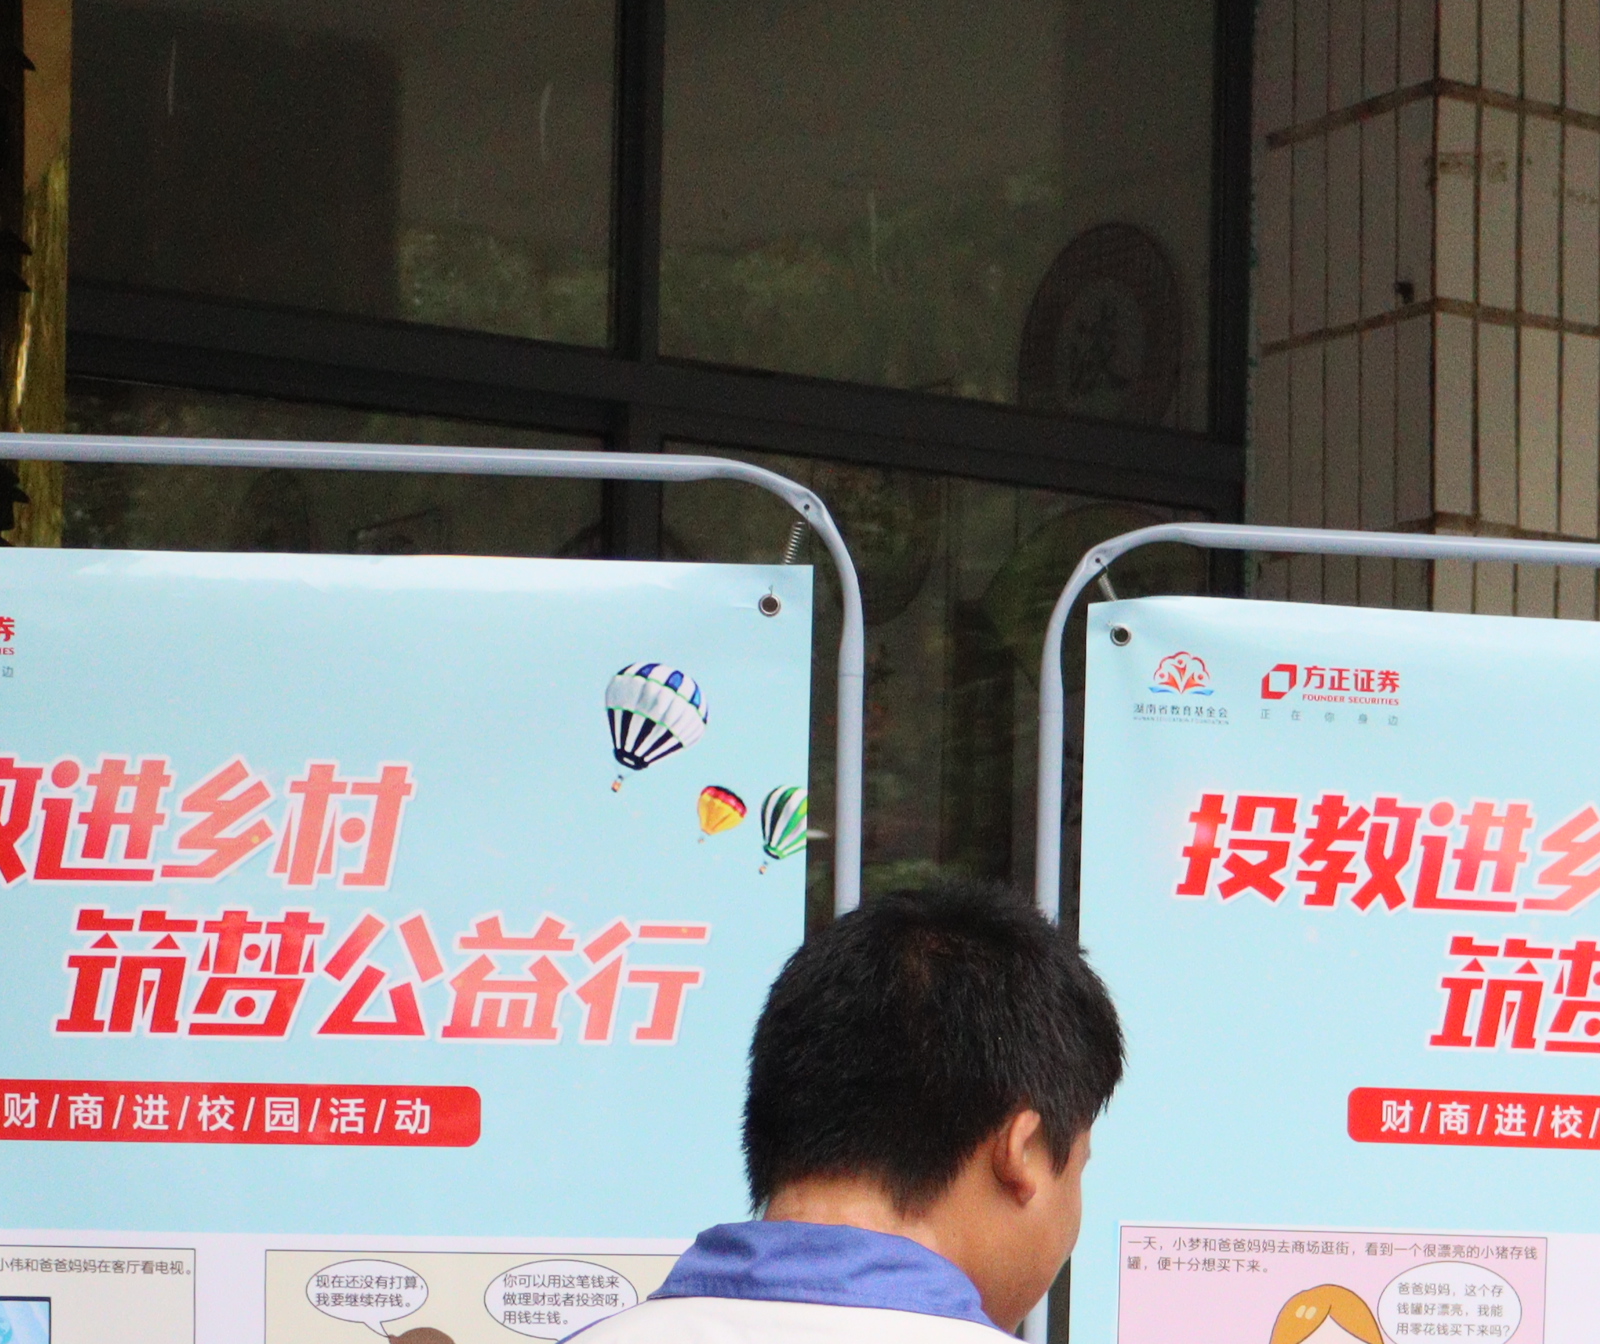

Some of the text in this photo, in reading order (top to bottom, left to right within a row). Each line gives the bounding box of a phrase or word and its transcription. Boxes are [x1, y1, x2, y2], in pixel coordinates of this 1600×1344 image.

[1303, 665, 1400, 694] 方正证券
[1302, 694, 1399, 706] FOUNDER SECURITIES
[1133, 702, 1229, 719] 湖南省教育基金会
[55, 908, 708, 1043] 筑梦公益行
[315, 1275, 425, 1290] 现在还没有打算，
[502, 1274, 620, 1290] 你可以用这笔钱来
[1397, 1282, 1504, 1298] 爸爸妈妈，这个存
[315, 1292, 413, 1309] 我要继续存钱。
[502, 1292, 626, 1308] 做理财或者投资呀，
[502, 1311, 570, 1326] 用钱生钱。
[1396, 1302, 1504, 1319] 钱罐好漂亮，我能
[1396, 1321, 1511, 1339] 用零花钱买下来吗？
